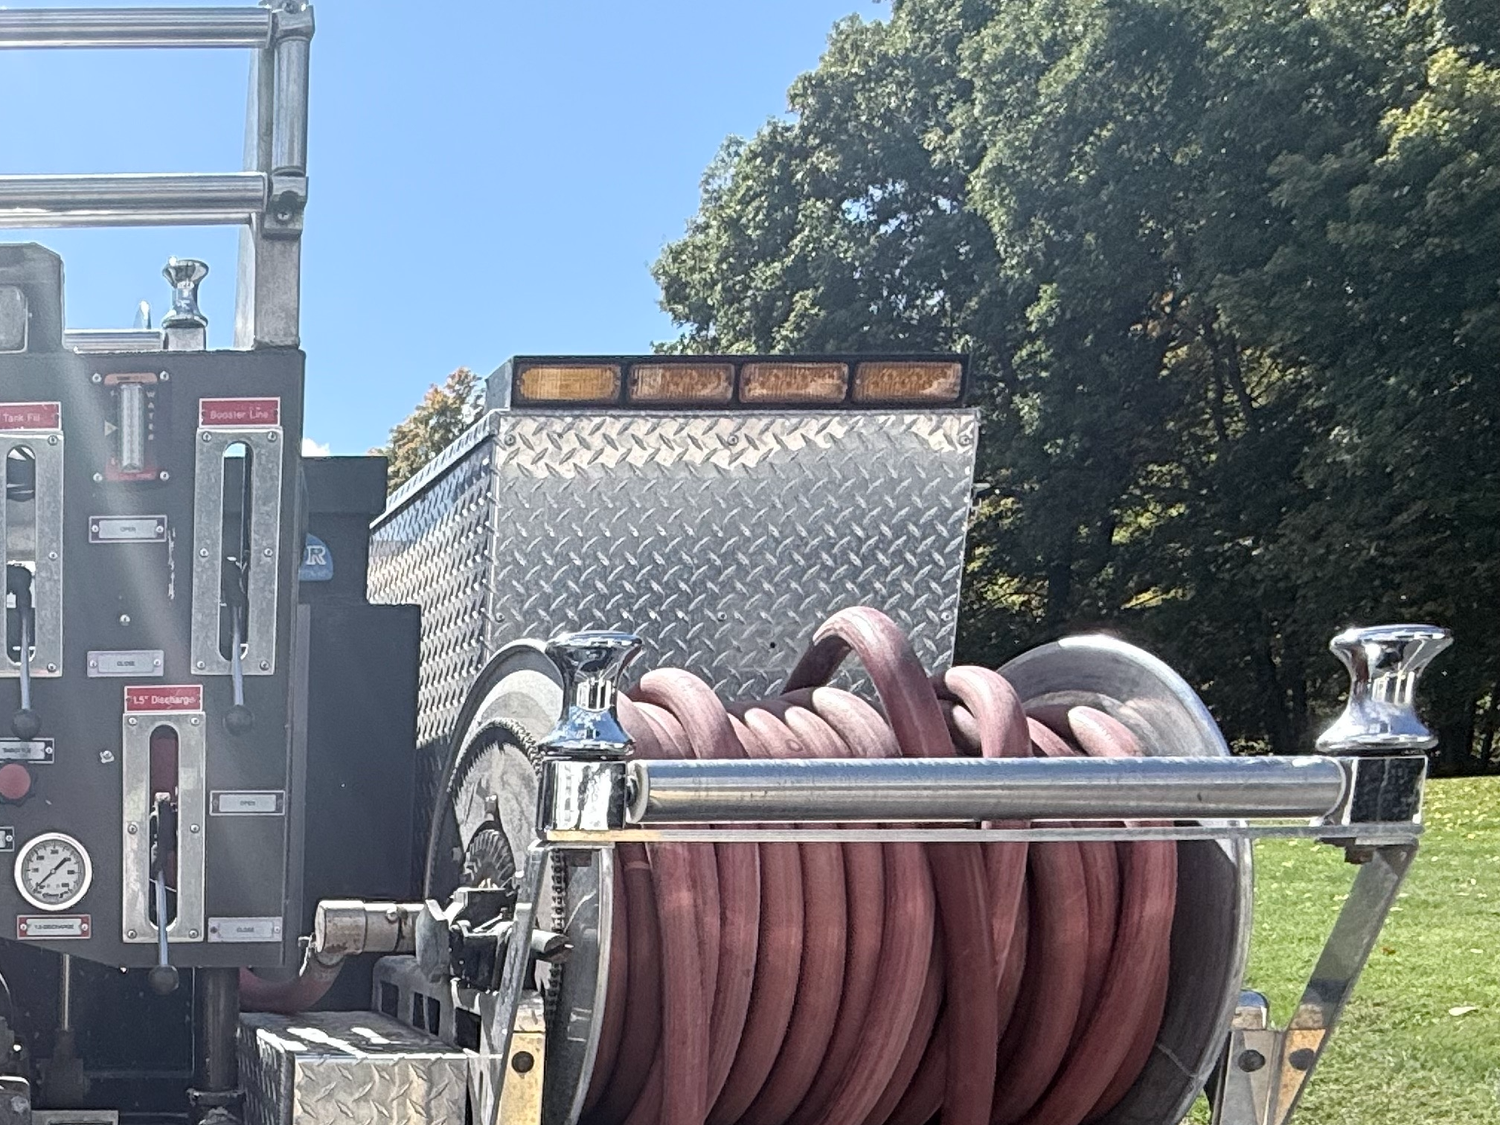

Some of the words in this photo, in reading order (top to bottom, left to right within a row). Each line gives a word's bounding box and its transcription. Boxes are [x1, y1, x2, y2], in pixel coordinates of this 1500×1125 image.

[2, 412, 24, 423] Tank
[26, 412, 41, 422] Fill
[209, 410, 247, 420] Booster
[248, 409, 269, 420] Line
[150, 694, 197, 706] Discharge
